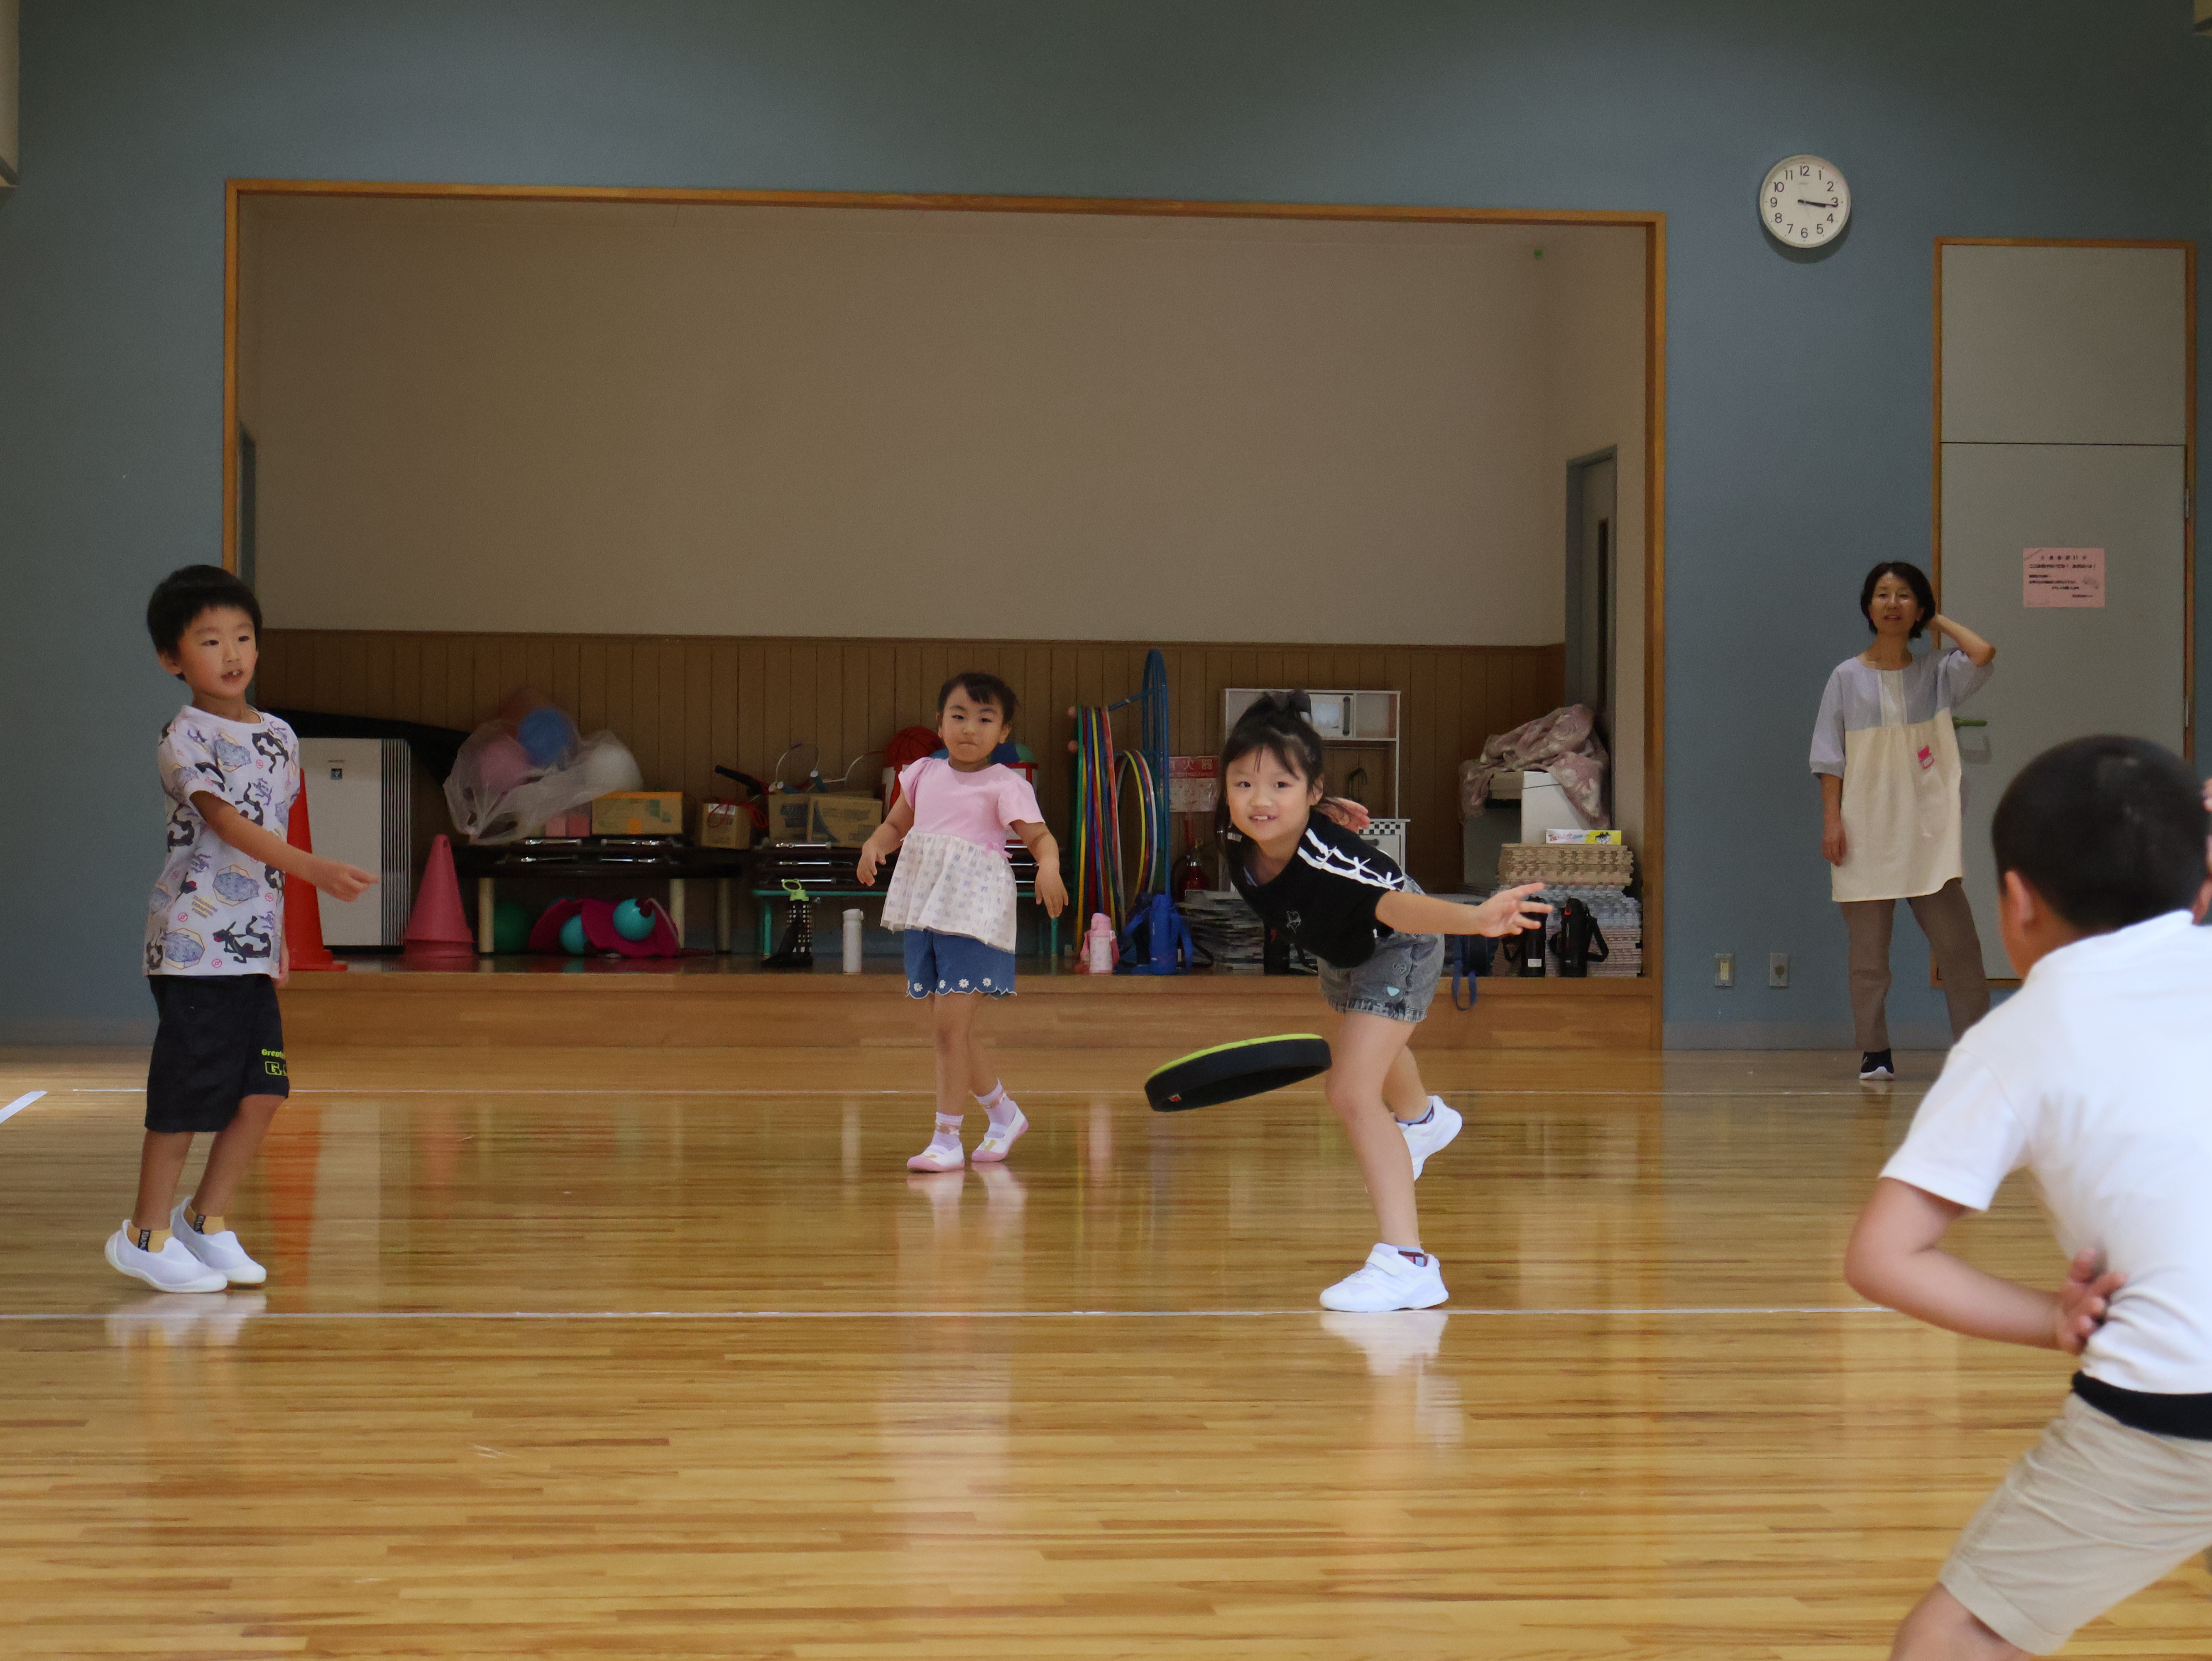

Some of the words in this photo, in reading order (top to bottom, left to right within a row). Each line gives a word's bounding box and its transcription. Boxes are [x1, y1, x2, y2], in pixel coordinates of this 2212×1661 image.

[1786, 170, 1793, 180] 11
[1800, 165, 1809, 176] 12
[1818, 170, 1822, 180] 1
[1774, 182, 1784, 192] 10
[1827, 181, 1834, 191] 2
[1770, 197, 1777, 207] 9
[1831, 197, 1838, 207] 3
[1775, 213, 1782, 223] 8
[1826, 213, 1834, 223] 4
[1787, 223, 1794, 233] 7
[1801, 228, 1808, 238] 6
[1816, 224, 1823, 234] 5
